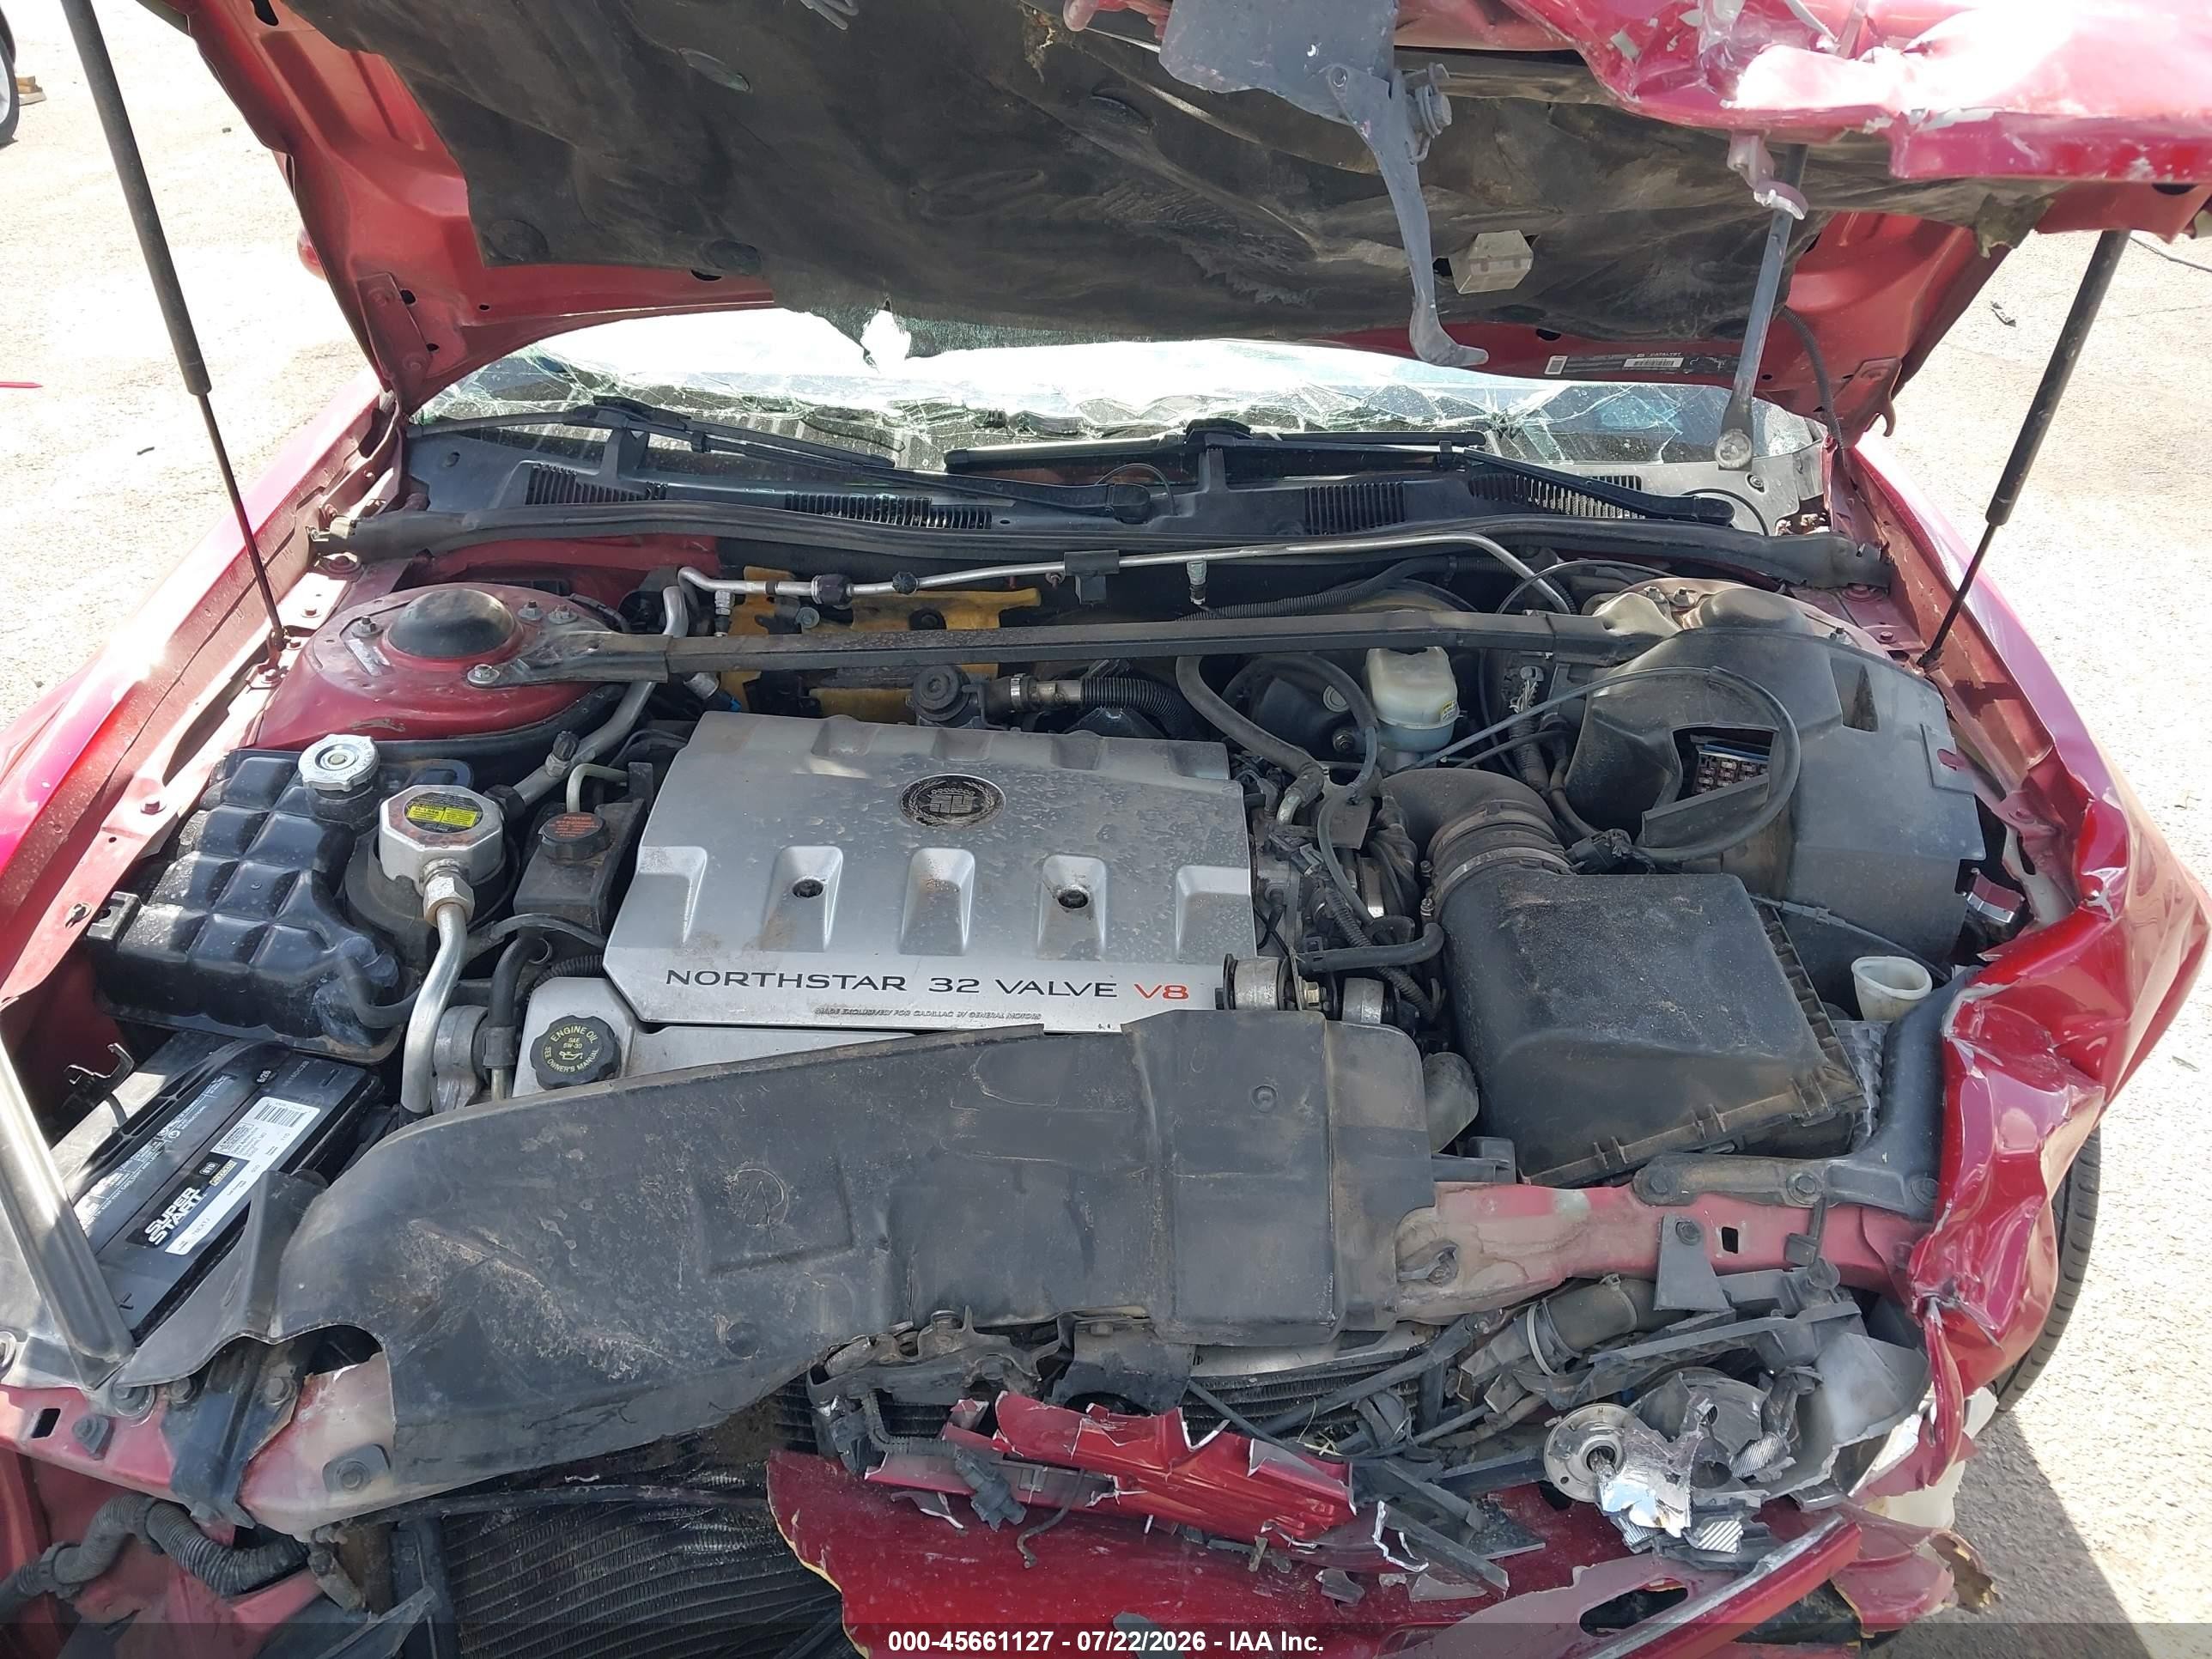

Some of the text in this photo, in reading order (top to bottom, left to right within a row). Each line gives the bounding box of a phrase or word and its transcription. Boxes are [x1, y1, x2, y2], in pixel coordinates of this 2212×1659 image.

[665, 969, 1189, 1000] NORTHSTAR 32 VALVE V8
[969, 1011, 1005, 1019] GENERAL
[550, 1025, 599, 1044] ENGINE OIL
[544, 1046, 599, 1073] SEE OWNER'S MANUAL
[144, 1187, 198, 1234] SUPER
[148, 1188, 204, 1245] START
